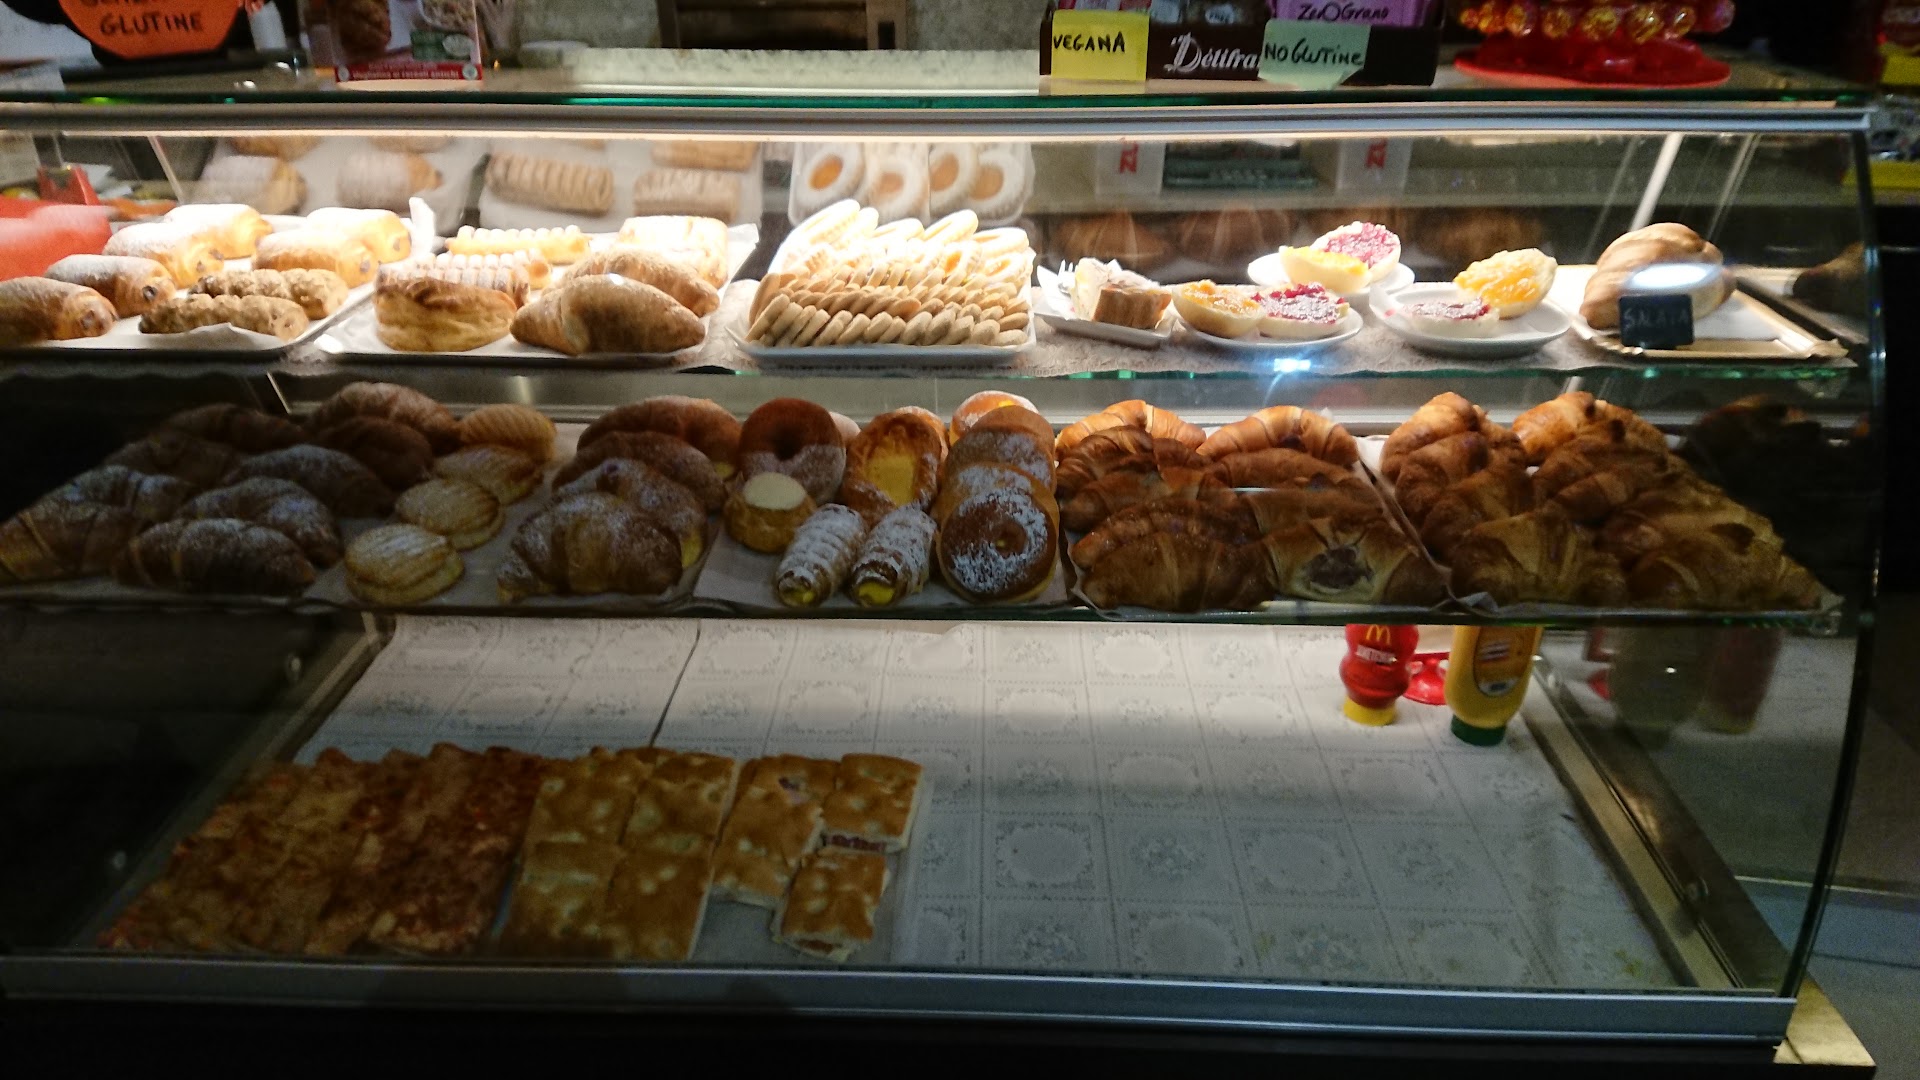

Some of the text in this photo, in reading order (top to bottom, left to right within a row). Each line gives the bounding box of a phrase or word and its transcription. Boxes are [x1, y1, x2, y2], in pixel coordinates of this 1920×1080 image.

[100, 11, 204, 36] GLUTINE
[1053, 31, 1126, 53] VEGANA
[1264, 42, 1289, 62] NO
